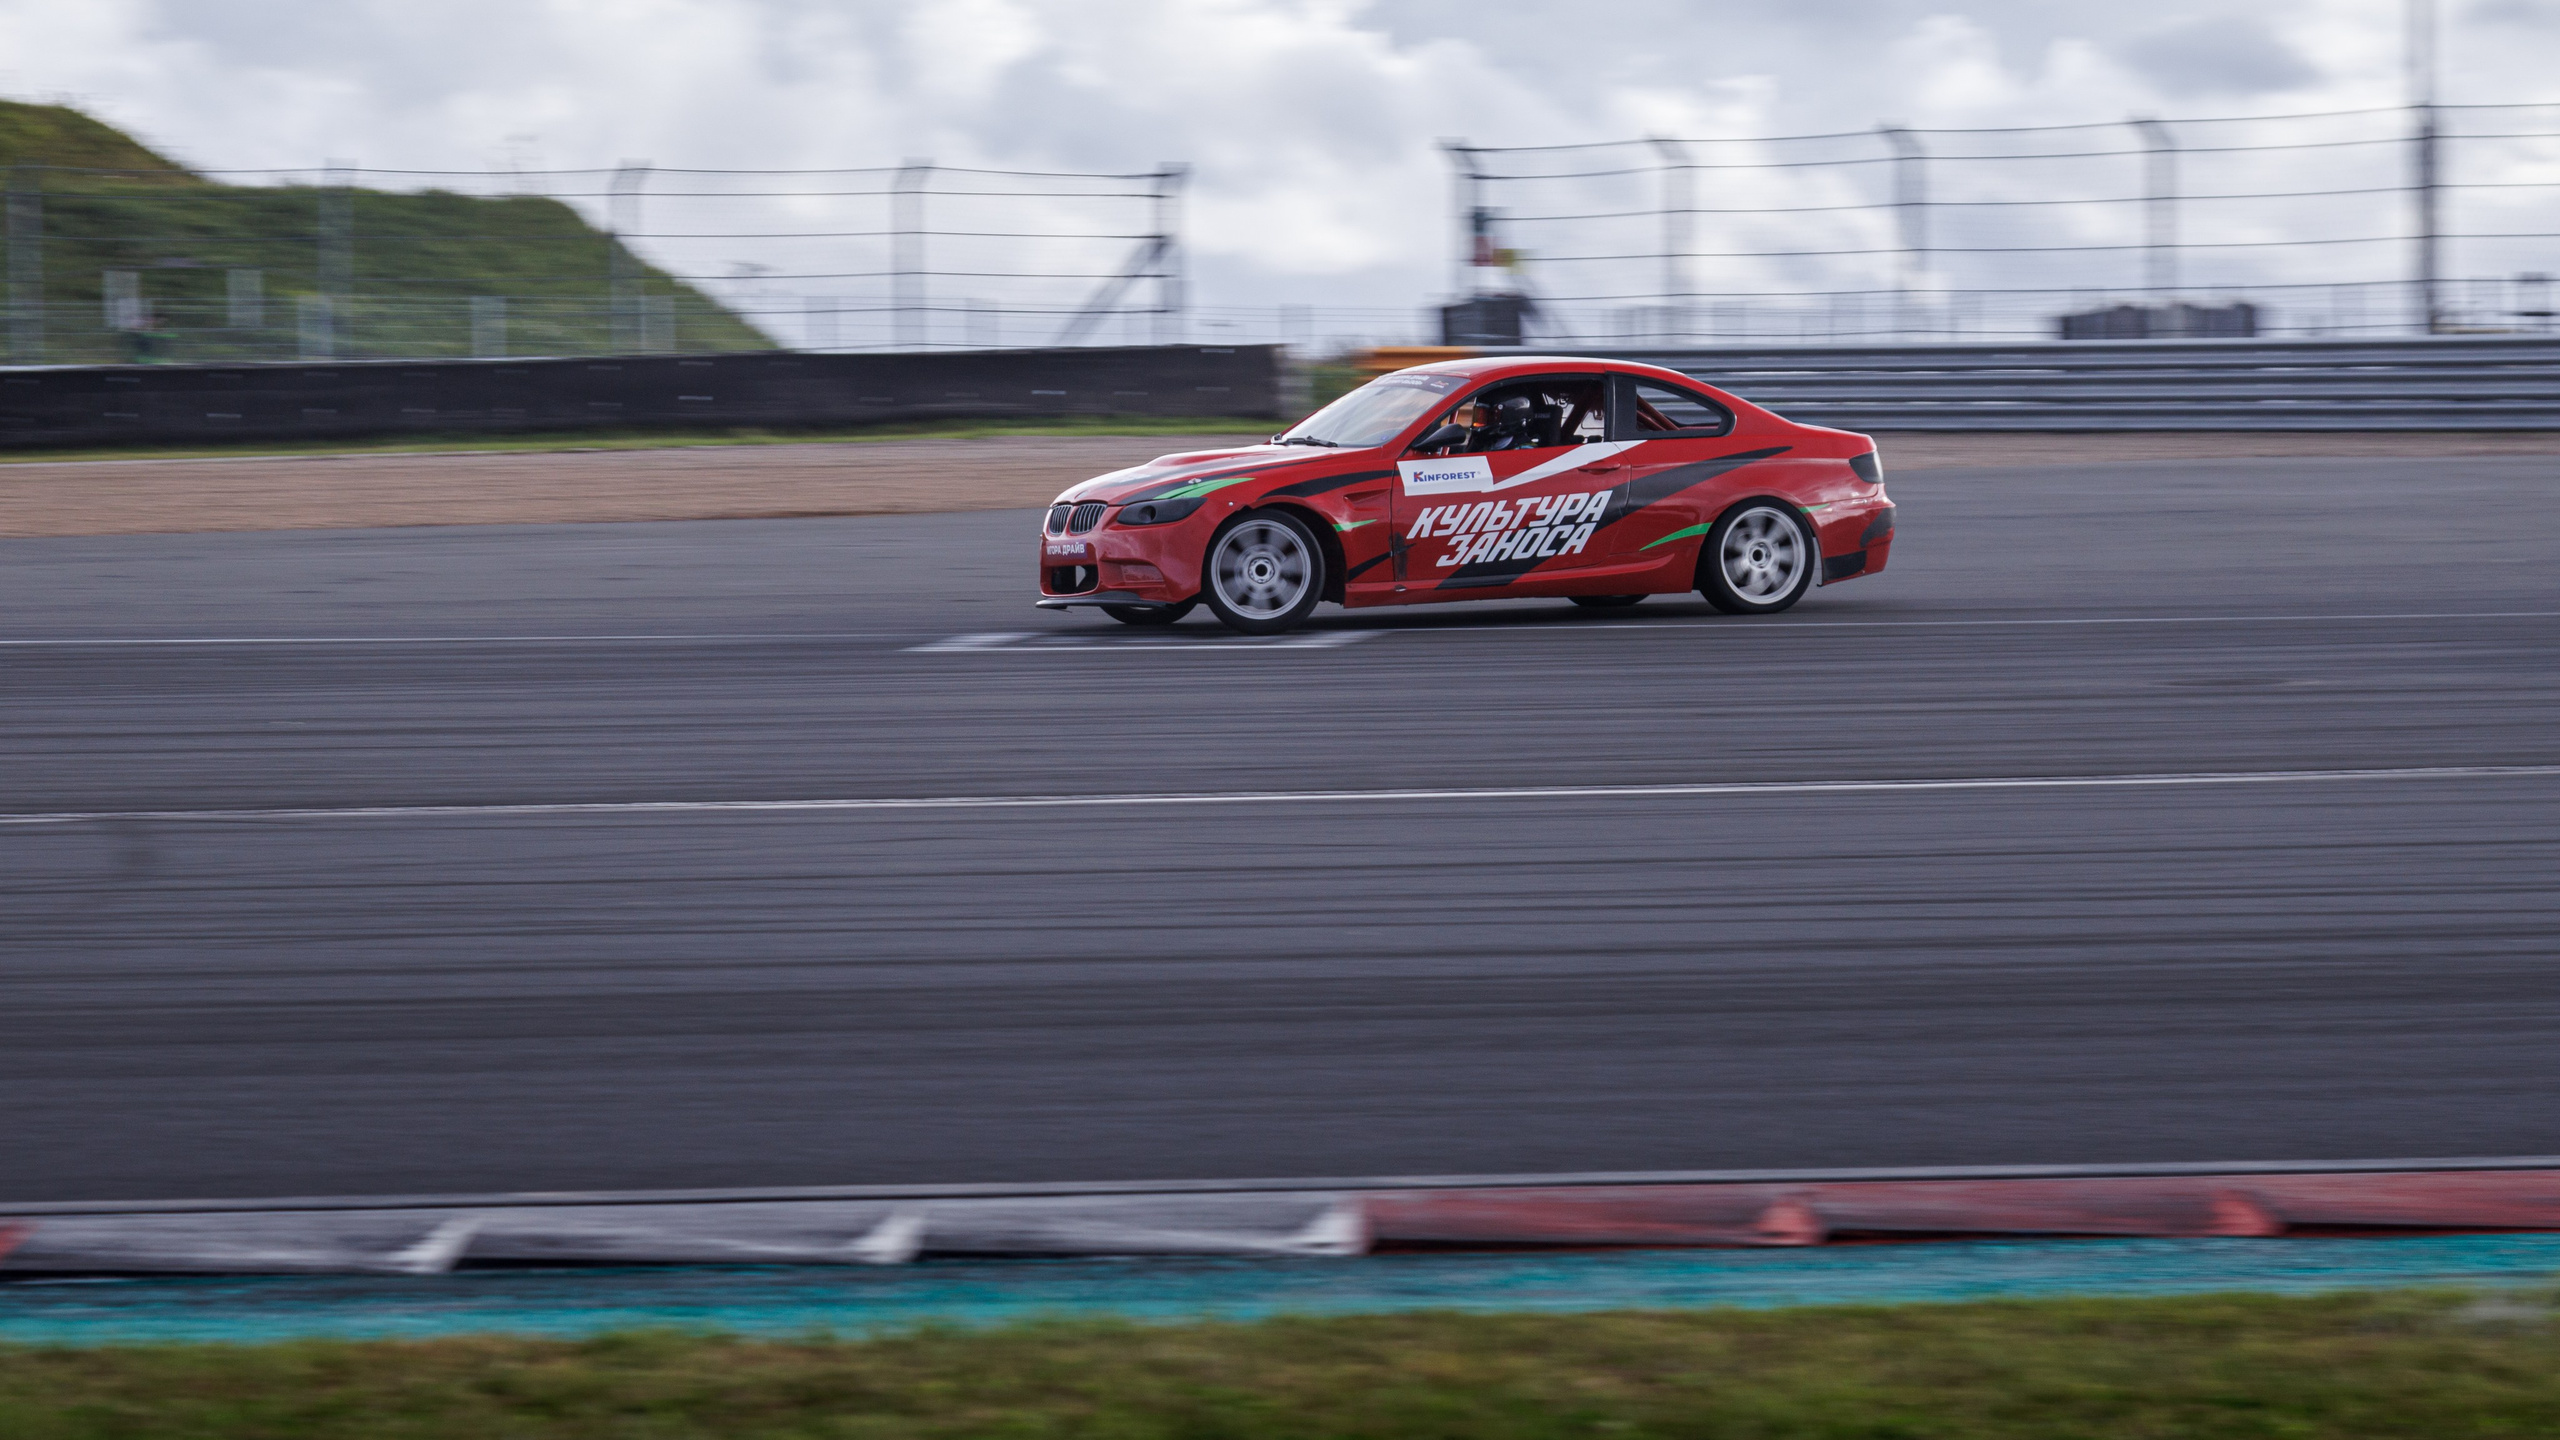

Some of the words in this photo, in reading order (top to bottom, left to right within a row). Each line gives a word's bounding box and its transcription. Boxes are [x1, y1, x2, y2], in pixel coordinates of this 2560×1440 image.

[1413, 471, 1476, 483] KINFOREST
[1406, 490, 1613, 539] КУЛЬТУРА
[1062, 542, 1085, 555] ДРАЙВ
[1435, 522, 1597, 567] ЗАНОСА
